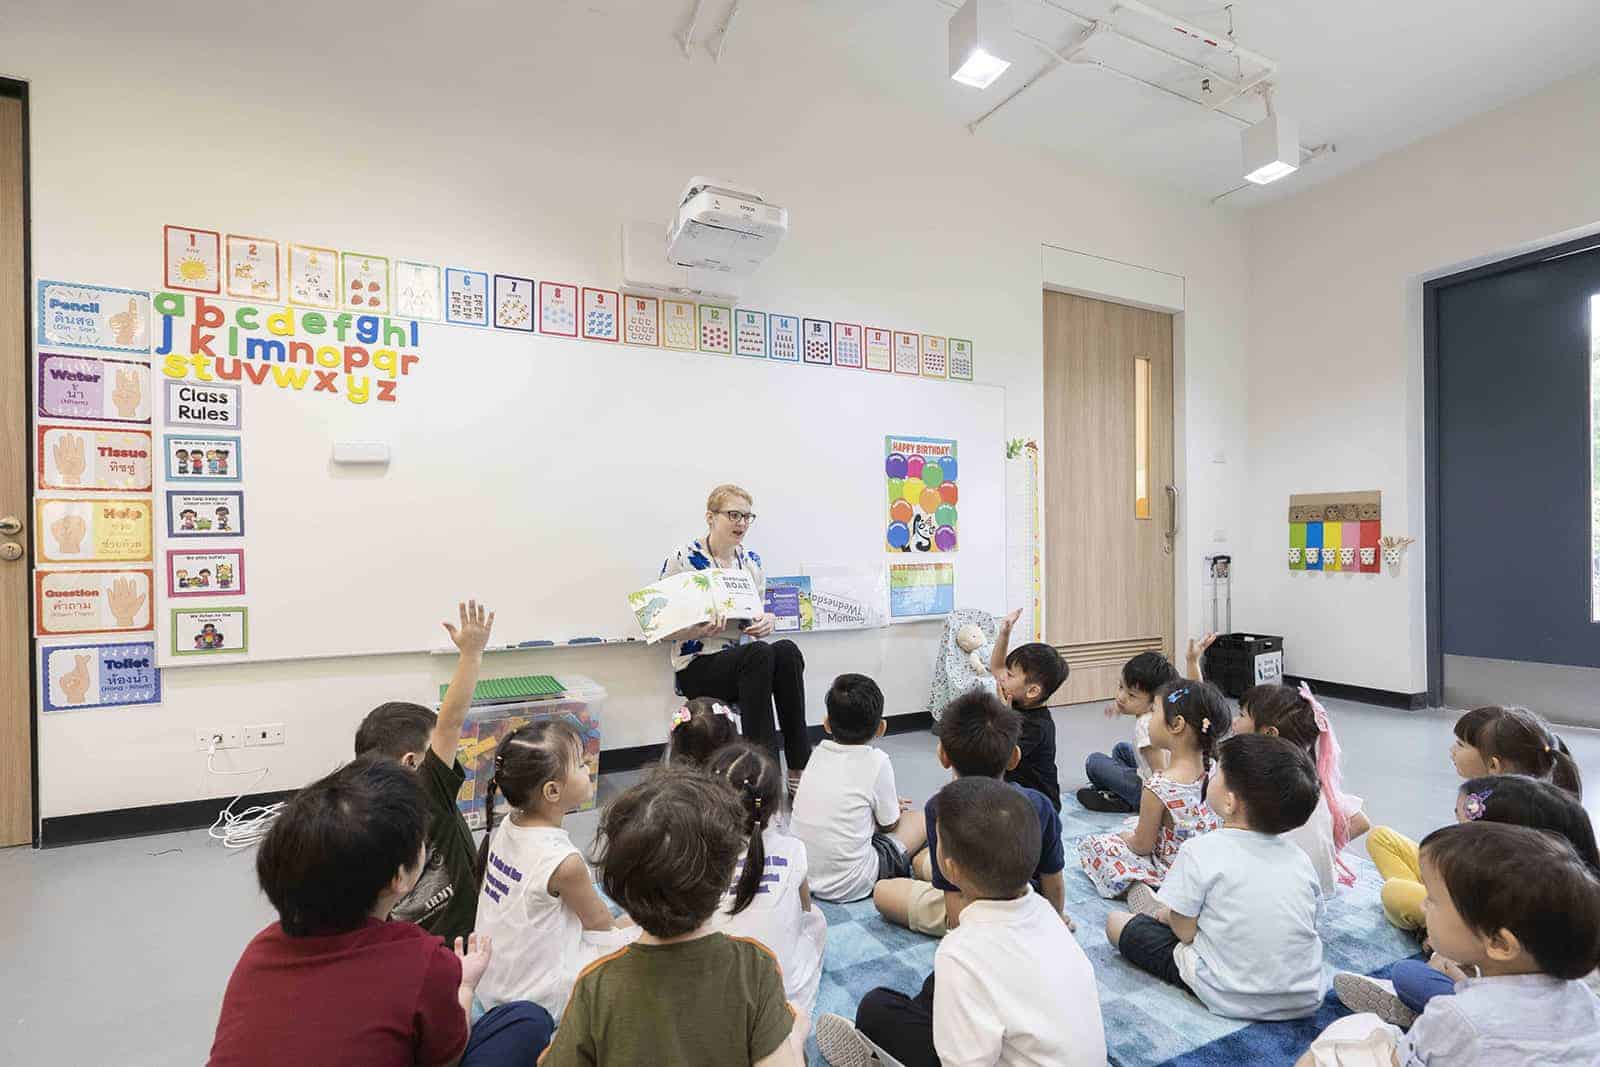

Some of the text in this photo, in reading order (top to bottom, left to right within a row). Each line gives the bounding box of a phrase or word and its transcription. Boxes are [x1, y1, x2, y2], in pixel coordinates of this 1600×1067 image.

[249, 244, 257, 255] 2
[463, 275, 471, 286] 6
[511, 282, 517, 292] 7
[597, 294, 604, 304] 9
[49, 298, 100, 314] Pencil
[636, 300, 646, 311] 10
[711, 309, 720, 320] 12
[746, 314, 755, 324] 13
[813, 323, 821, 332] 15
[50, 369, 101, 383] Water
[179, 387, 229, 404] Class
[178, 404, 230, 421] Rules
[97, 447, 148, 458] Tissue
[892, 440, 951, 456] HAPPY BIRTHDAY
[45, 589, 100, 598] Question
[812, 594, 858, 616] Wednesda
[103, 657, 149, 670] Toilet
